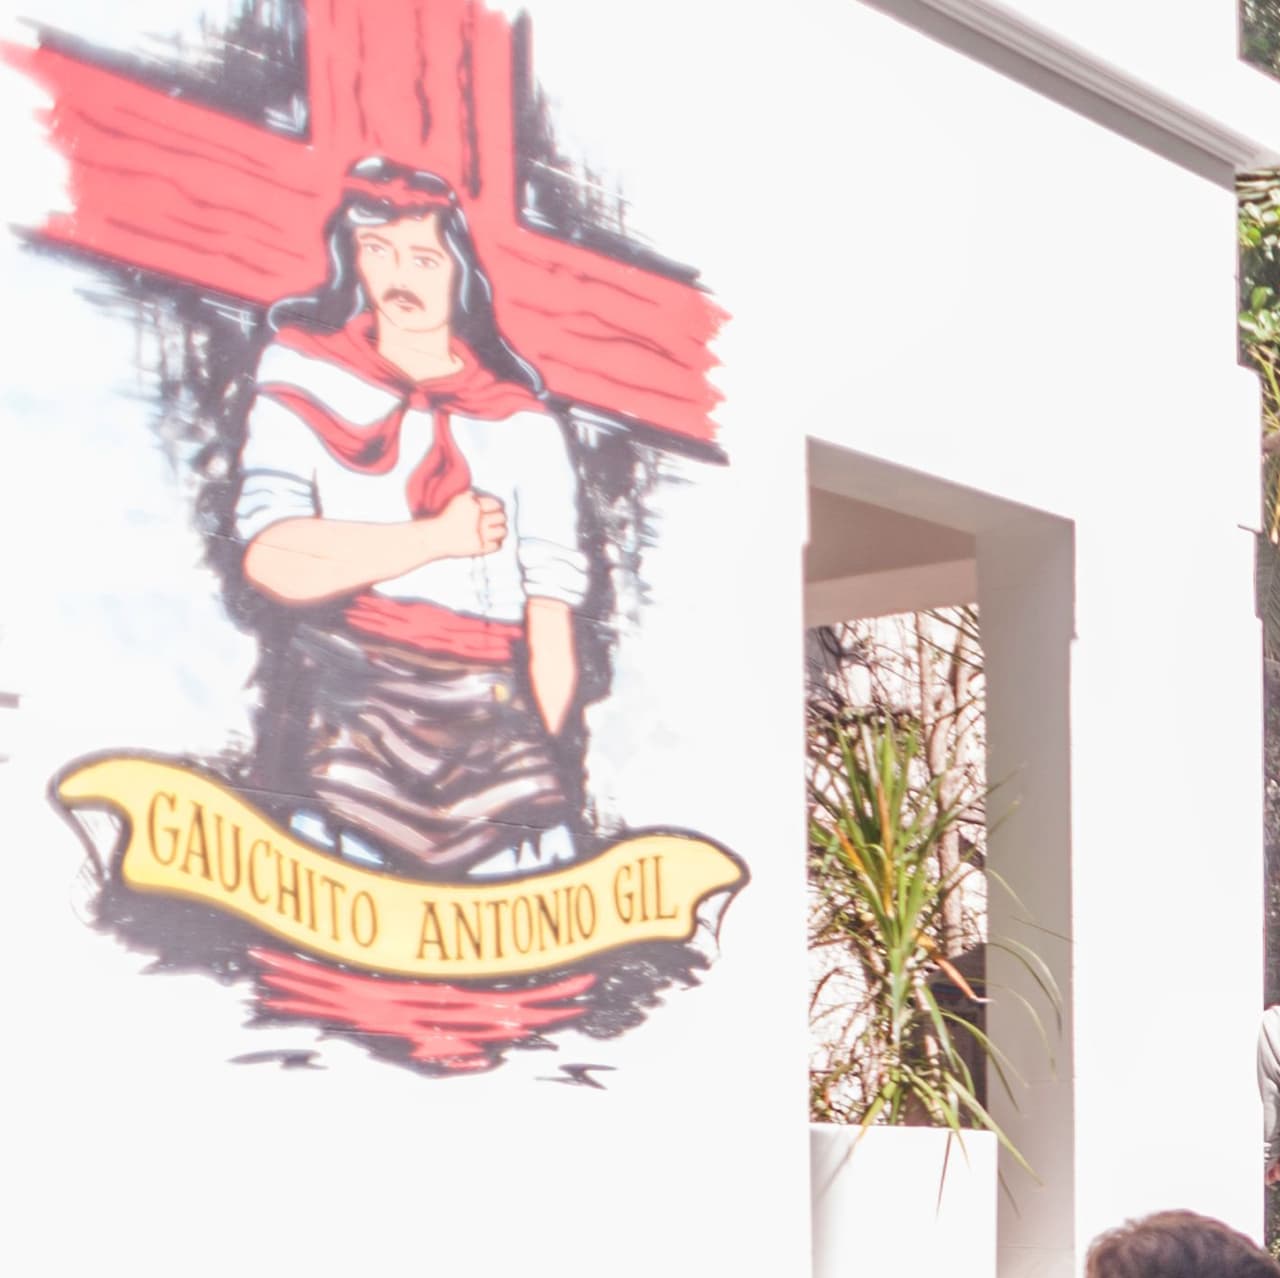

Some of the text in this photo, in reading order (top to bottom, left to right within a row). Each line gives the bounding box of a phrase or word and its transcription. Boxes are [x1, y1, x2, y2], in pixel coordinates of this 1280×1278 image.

[147, 791, 677, 960] GAUCHITO ANTONIO GIL
